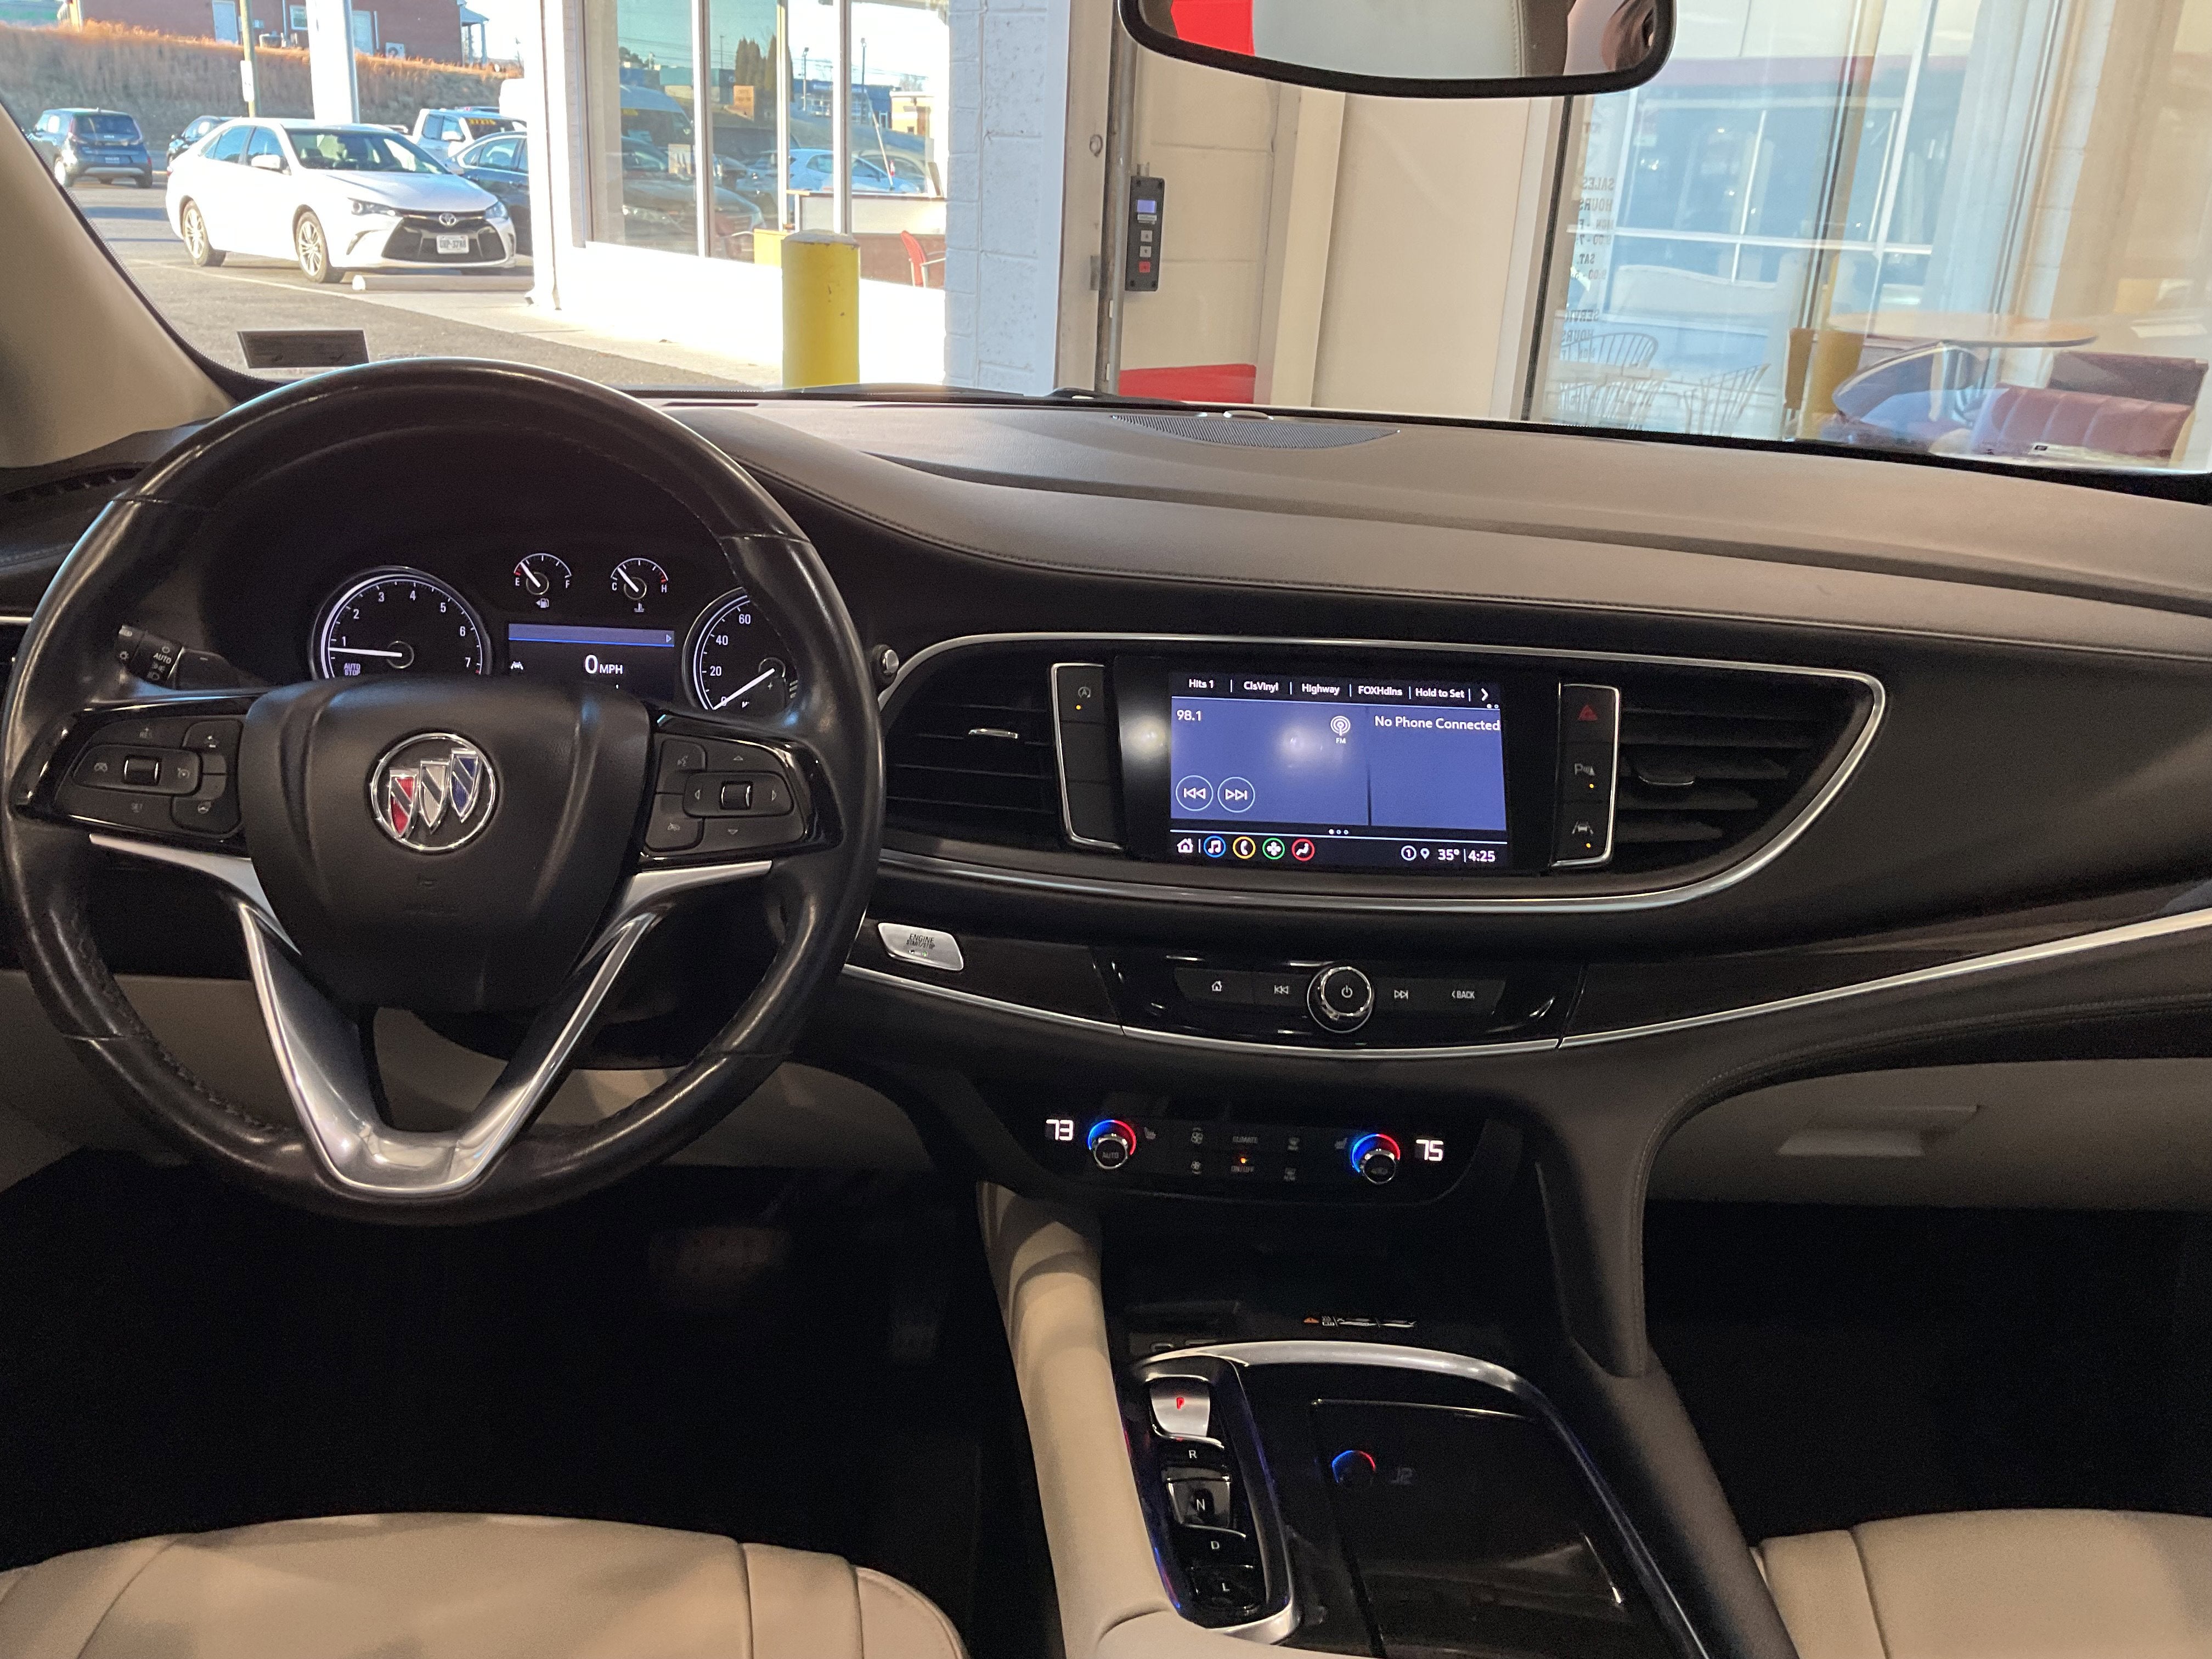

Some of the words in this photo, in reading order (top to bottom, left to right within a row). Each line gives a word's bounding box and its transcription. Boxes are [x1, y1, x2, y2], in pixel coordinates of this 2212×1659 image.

[515, 578, 520, 586] E
[565, 580, 570, 588] F
[611, 582, 617, 591] C
[661, 584, 667, 593] H
[378, 591, 385, 602] 3
[409, 590, 416, 600] 4
[440, 602, 446, 613] 5
[353, 608, 359, 619] 2
[738, 614, 751, 625] 60
[460, 626, 466, 636] 6
[342, 636, 346, 646] 1
[715, 635, 729, 646] 40
[153, 652, 172, 664] AUTO
[465, 657, 471, 667] 7
[585, 654, 598, 674] 0
[599, 663, 623, 674] MPH
[710, 665, 722, 676] 20
[1188, 679, 1207, 689] Hits
[1209, 680, 1214, 689] 1
[1301, 683, 1340, 695] Highway
[1415, 687, 1437, 697] Hold
[1438, 689, 1448, 698] to
[1449, 689, 1465, 698] Set
[1176, 709, 1201, 721] 98.1
[1374, 715, 1392, 727] No
[1395, 716, 1432, 729] Phone
[1435, 718, 1502, 731] Connected
[1468, 850, 1496, 862] 4:25
[909, 933, 935, 943] ENGINE
[1457, 990, 1475, 999] BACK
[1046, 1119, 1074, 1141] 73
[1415, 1139, 1444, 1162] 75
[1176, 1397, 1185, 1410] P
[1188, 1449, 1197, 1459] R
[1196, 1498, 1206, 1511] N
[1210, 1541, 1220, 1550] D
[1222, 1582, 1231, 1592] L
